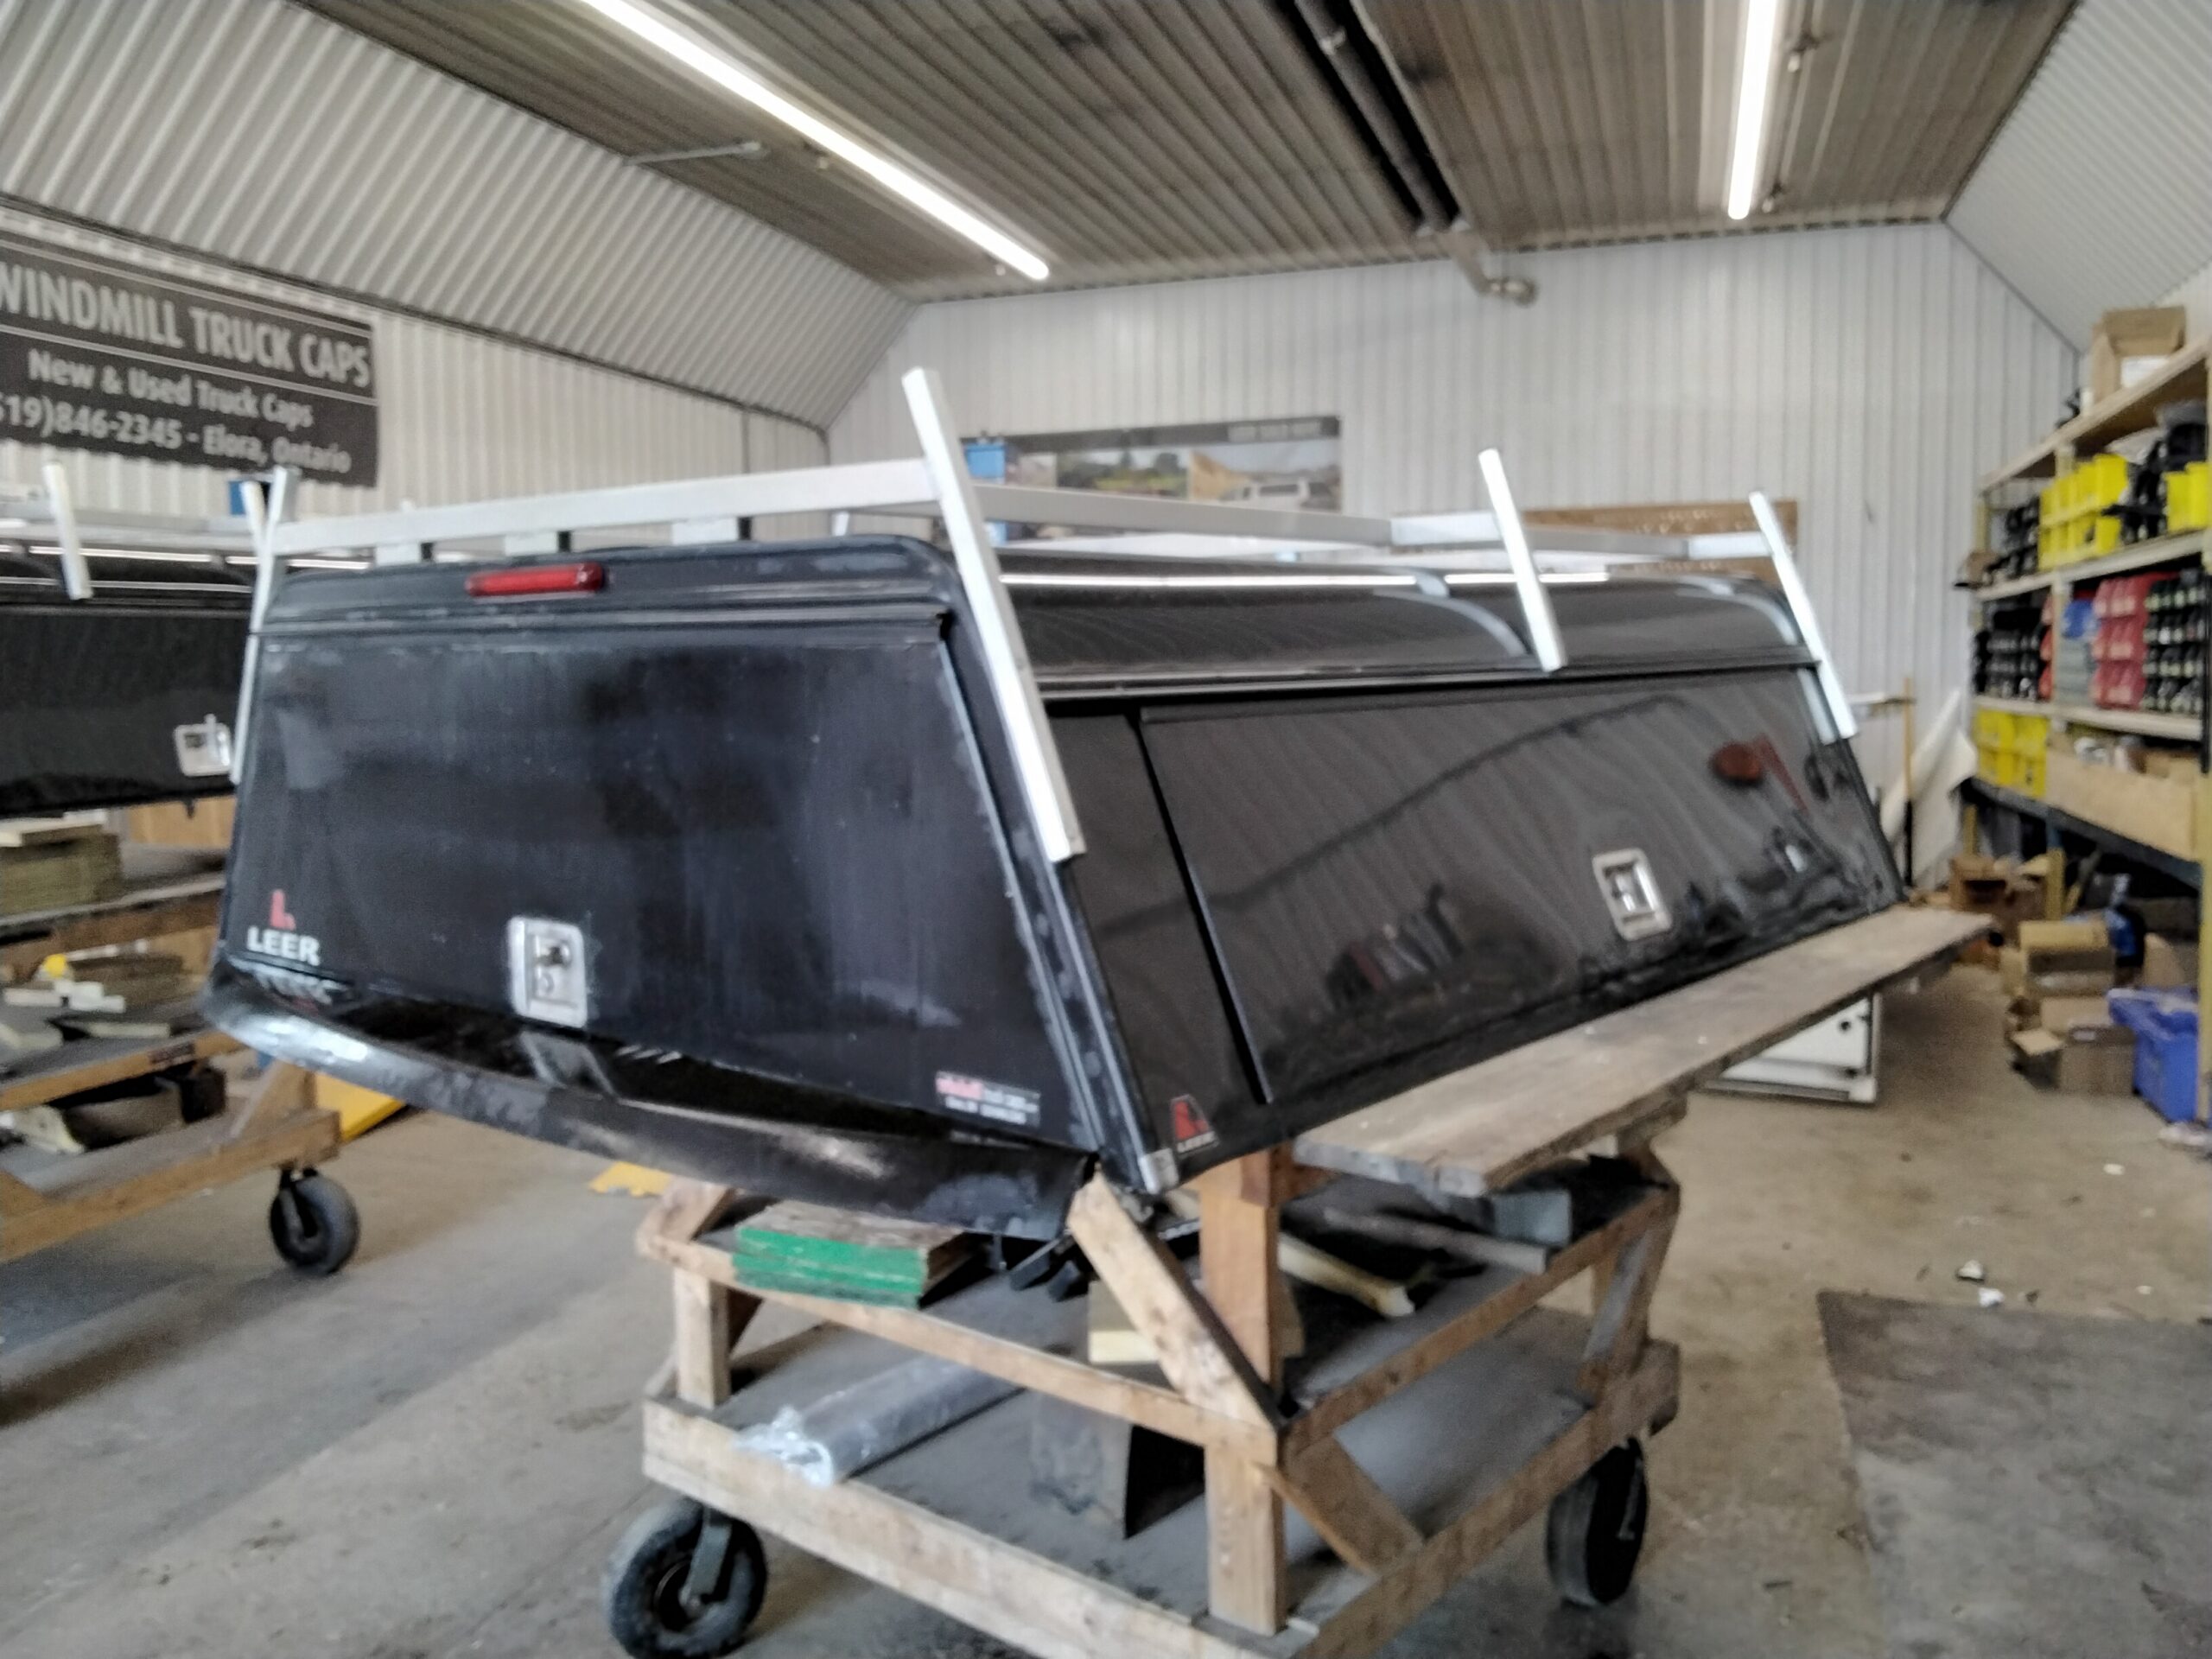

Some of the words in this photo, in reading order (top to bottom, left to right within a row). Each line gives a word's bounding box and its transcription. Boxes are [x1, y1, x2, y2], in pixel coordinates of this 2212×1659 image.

[189, 307, 294, 372] TRUCK
[299, 334, 372, 388] CAPS
[29, 348, 95, 389] New
[100, 365, 124, 395] &
[128, 368, 192, 407] Used
[196, 379, 258, 418] Truck
[262, 393, 315, 431] Caps
[272, 436, 352, 473] Ontario
[247, 926, 320, 966] LEER
